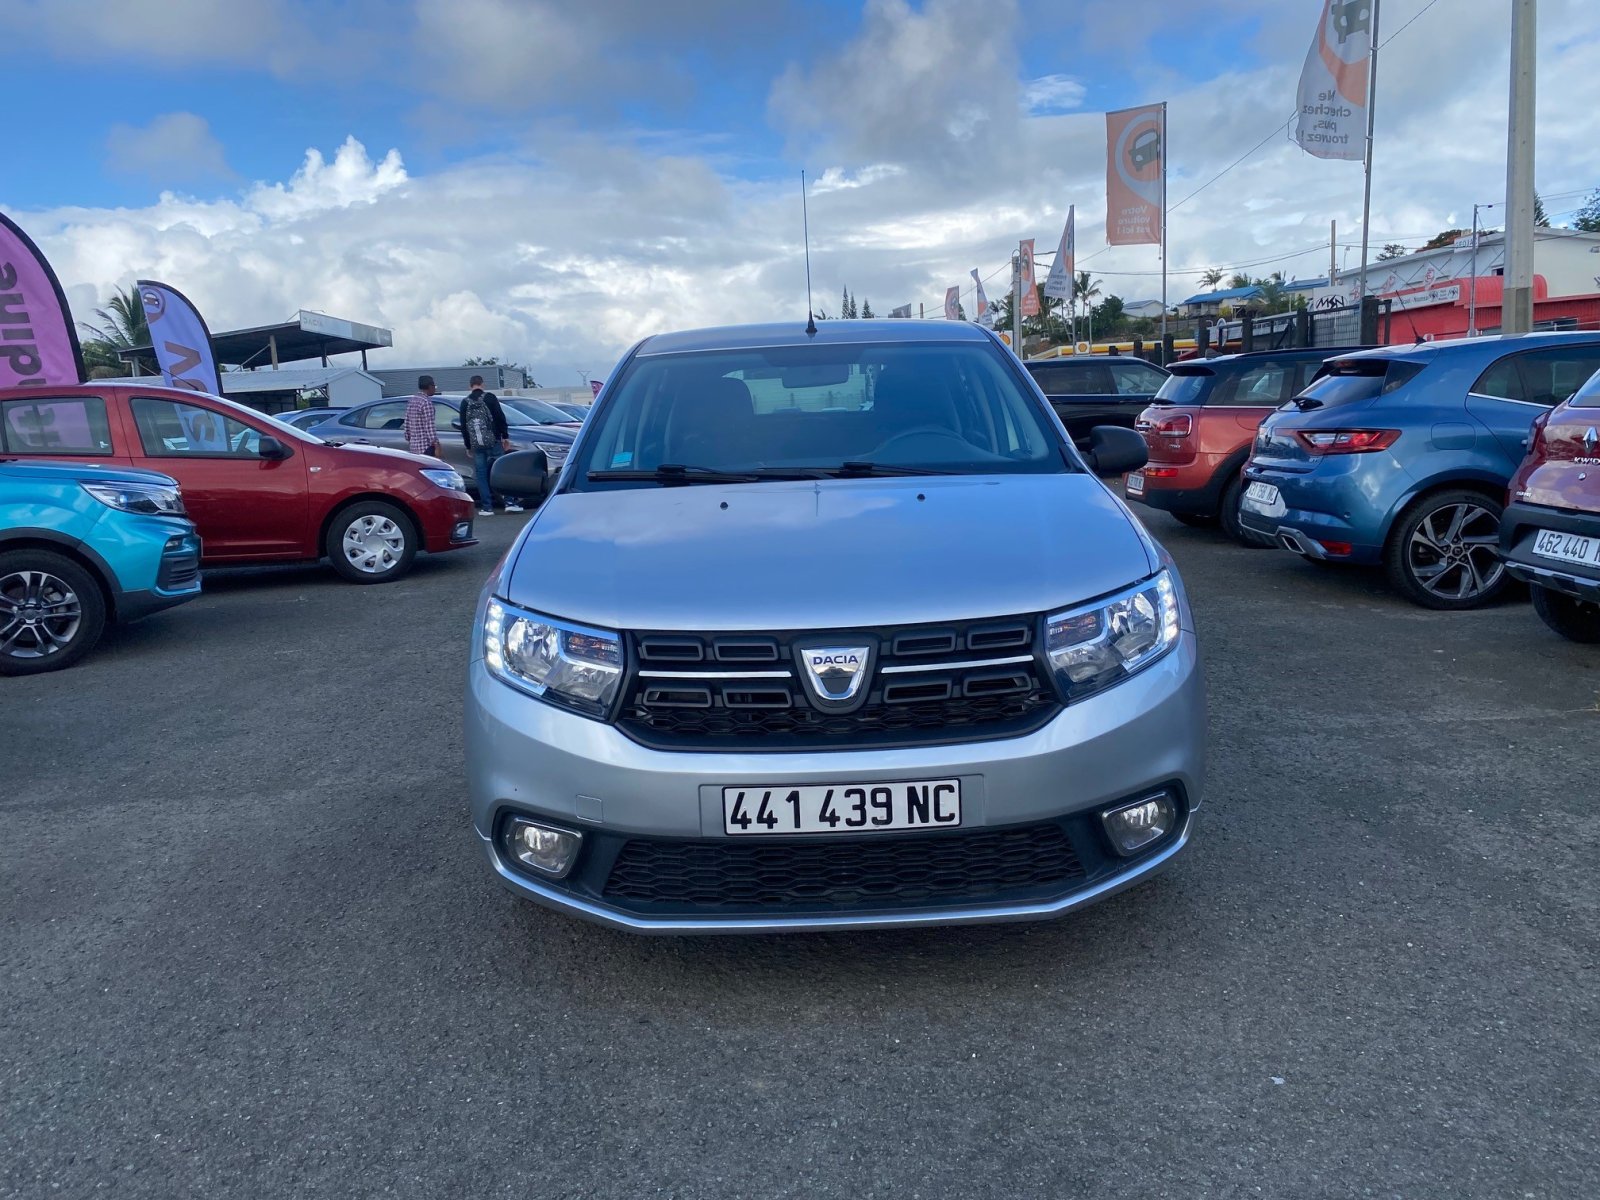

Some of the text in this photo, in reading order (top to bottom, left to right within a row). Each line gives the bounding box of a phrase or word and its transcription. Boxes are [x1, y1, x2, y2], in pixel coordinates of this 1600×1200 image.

[1538, 532, 1563, 554] 462
[1563, 536, 1589, 559] 440
[813, 655, 858, 665] DACIA
[730, 784, 955, 829] 441 439 NC
